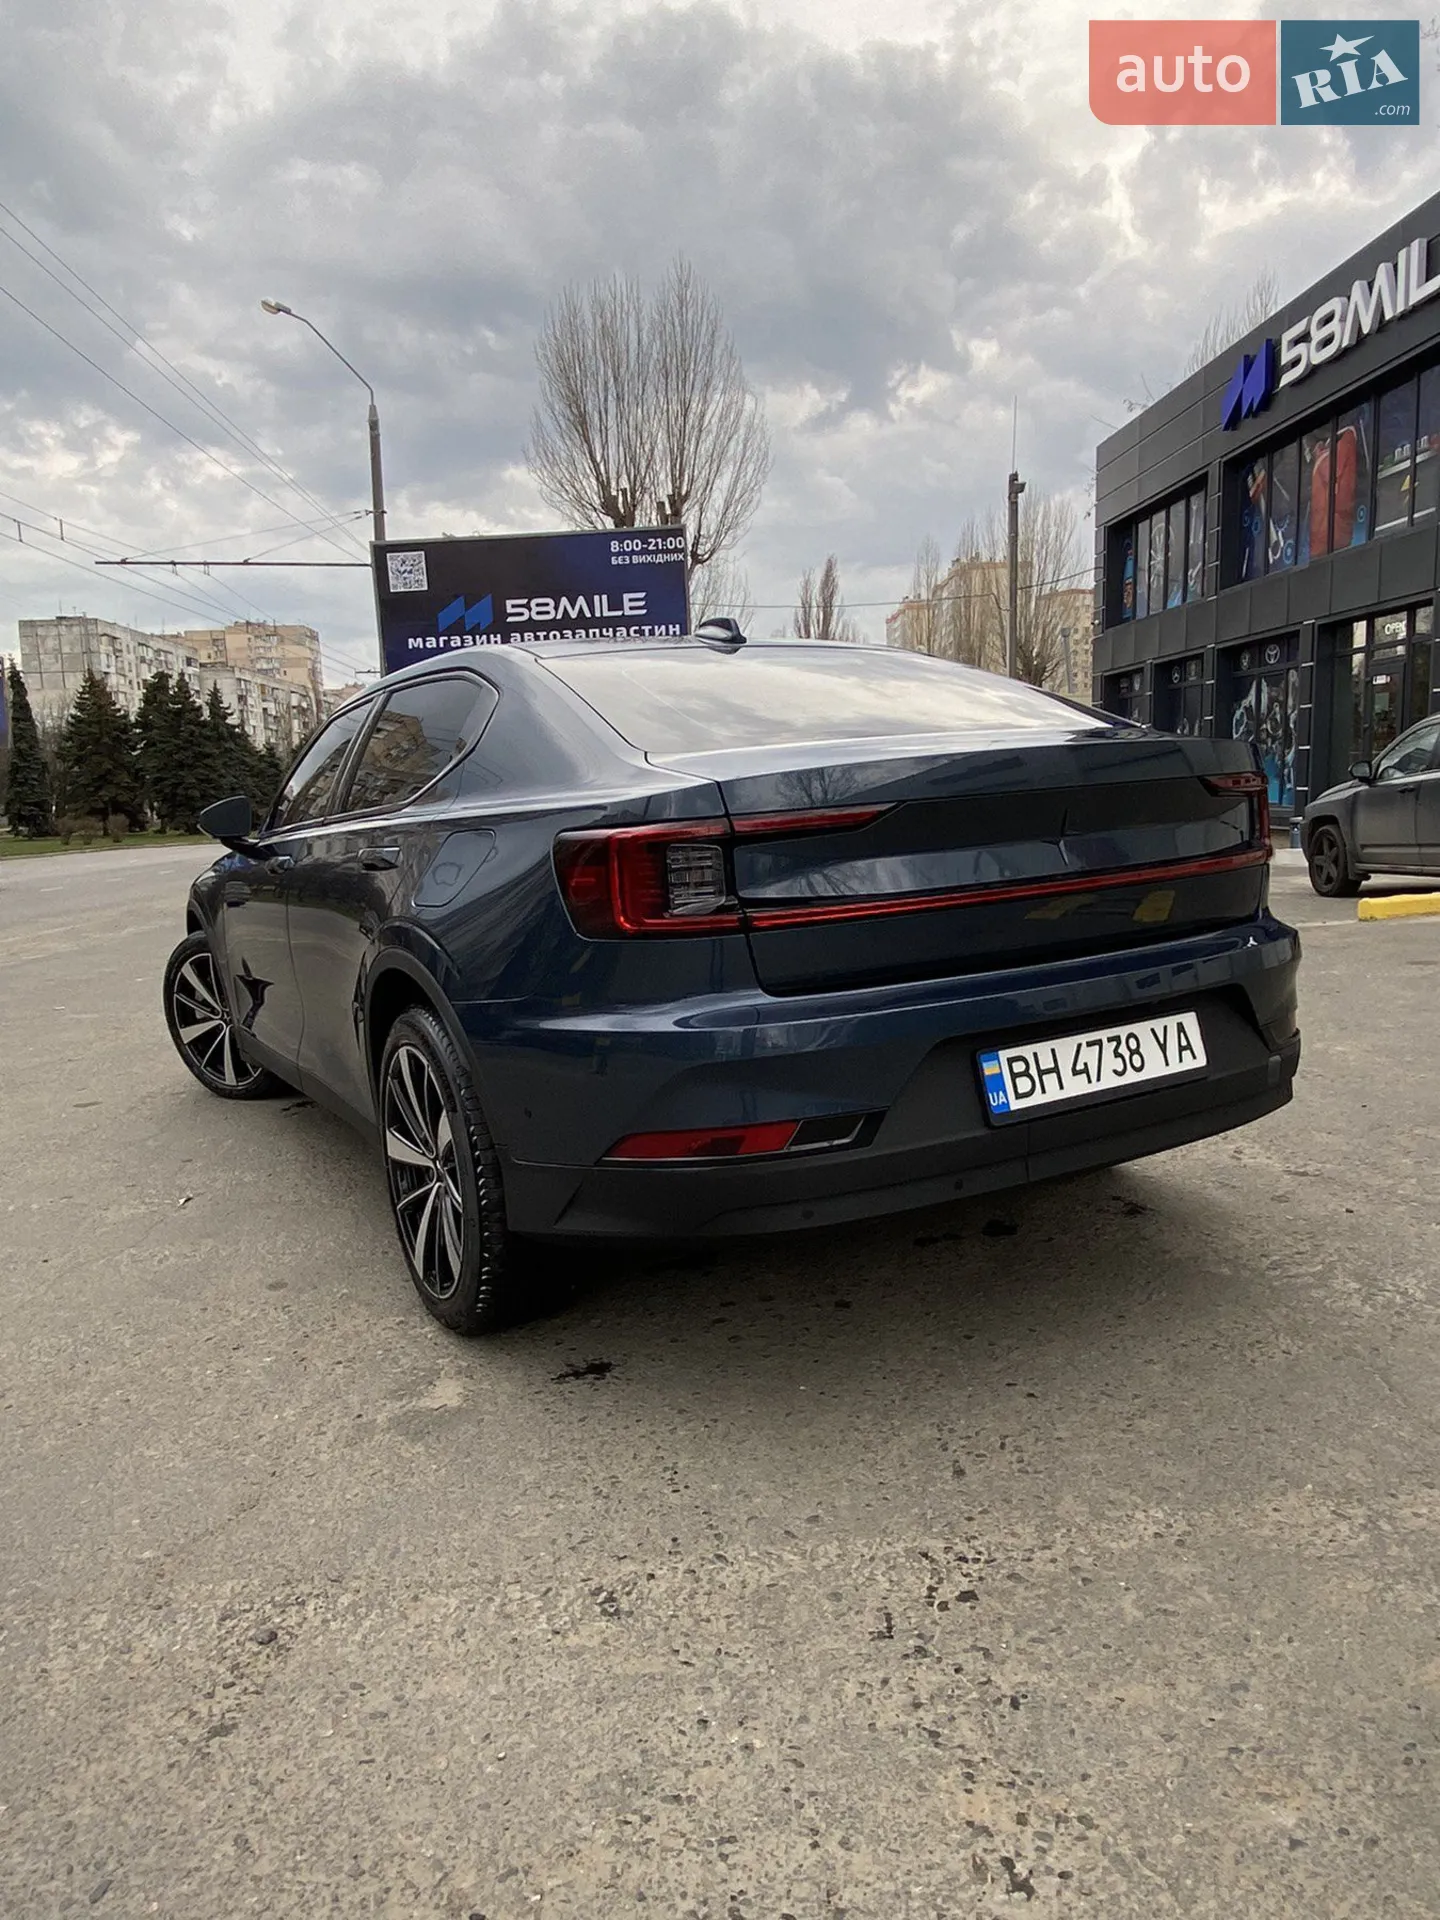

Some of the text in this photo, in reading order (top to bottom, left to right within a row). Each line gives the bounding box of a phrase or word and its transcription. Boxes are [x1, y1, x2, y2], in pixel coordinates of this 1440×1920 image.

[610, 537, 685, 552] 8:00-21:00
[632, 552, 685, 564] ВИХІДНИХ
[505, 592, 648, 622] 58MILE
[408, 623, 681, 649] магазин автозапчастин
[1006, 1021, 1197, 1100] BH 4738 YA
[988, 1091, 1008, 1107] UA
